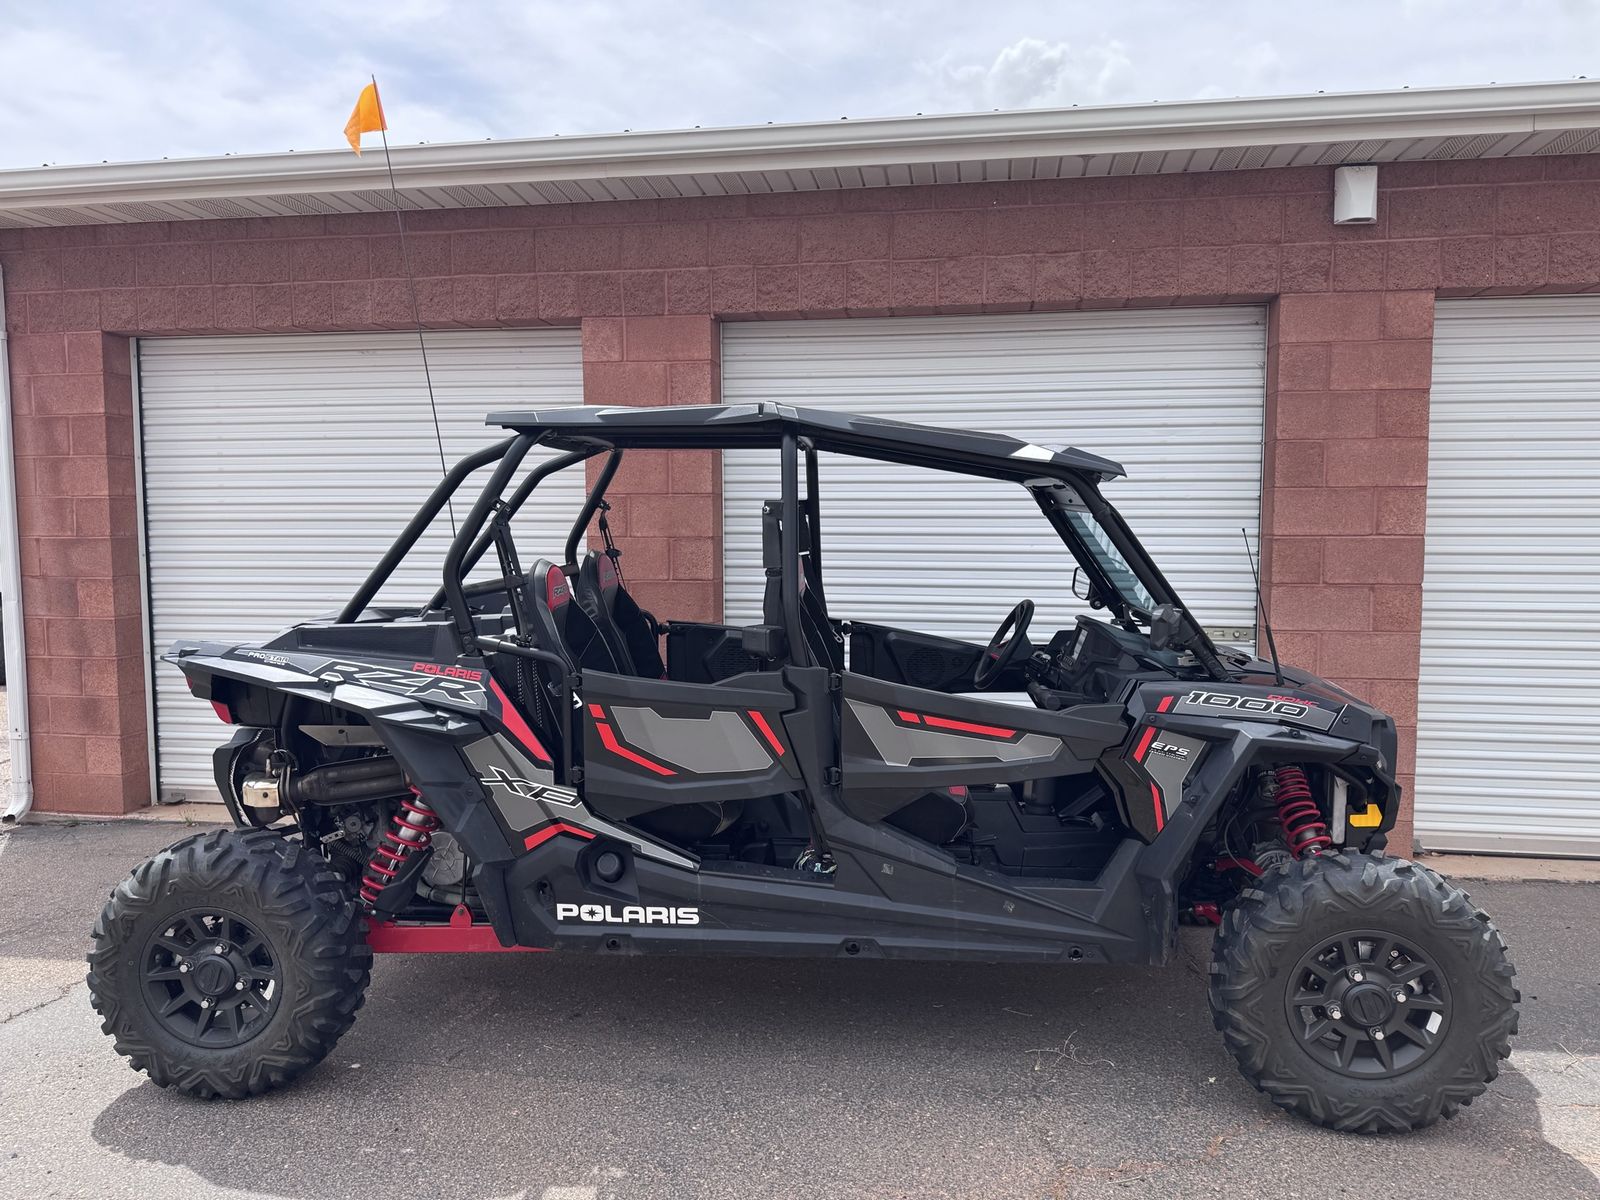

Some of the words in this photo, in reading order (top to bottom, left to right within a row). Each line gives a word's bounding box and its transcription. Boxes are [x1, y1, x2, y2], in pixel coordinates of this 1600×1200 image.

[309, 659, 486, 705] RZR
[412, 662, 482, 681] POLARIS
[1186, 690, 1309, 719] 1000
[1151, 741, 1191, 756] EPS
[556, 903, 700, 925] POLARIS
